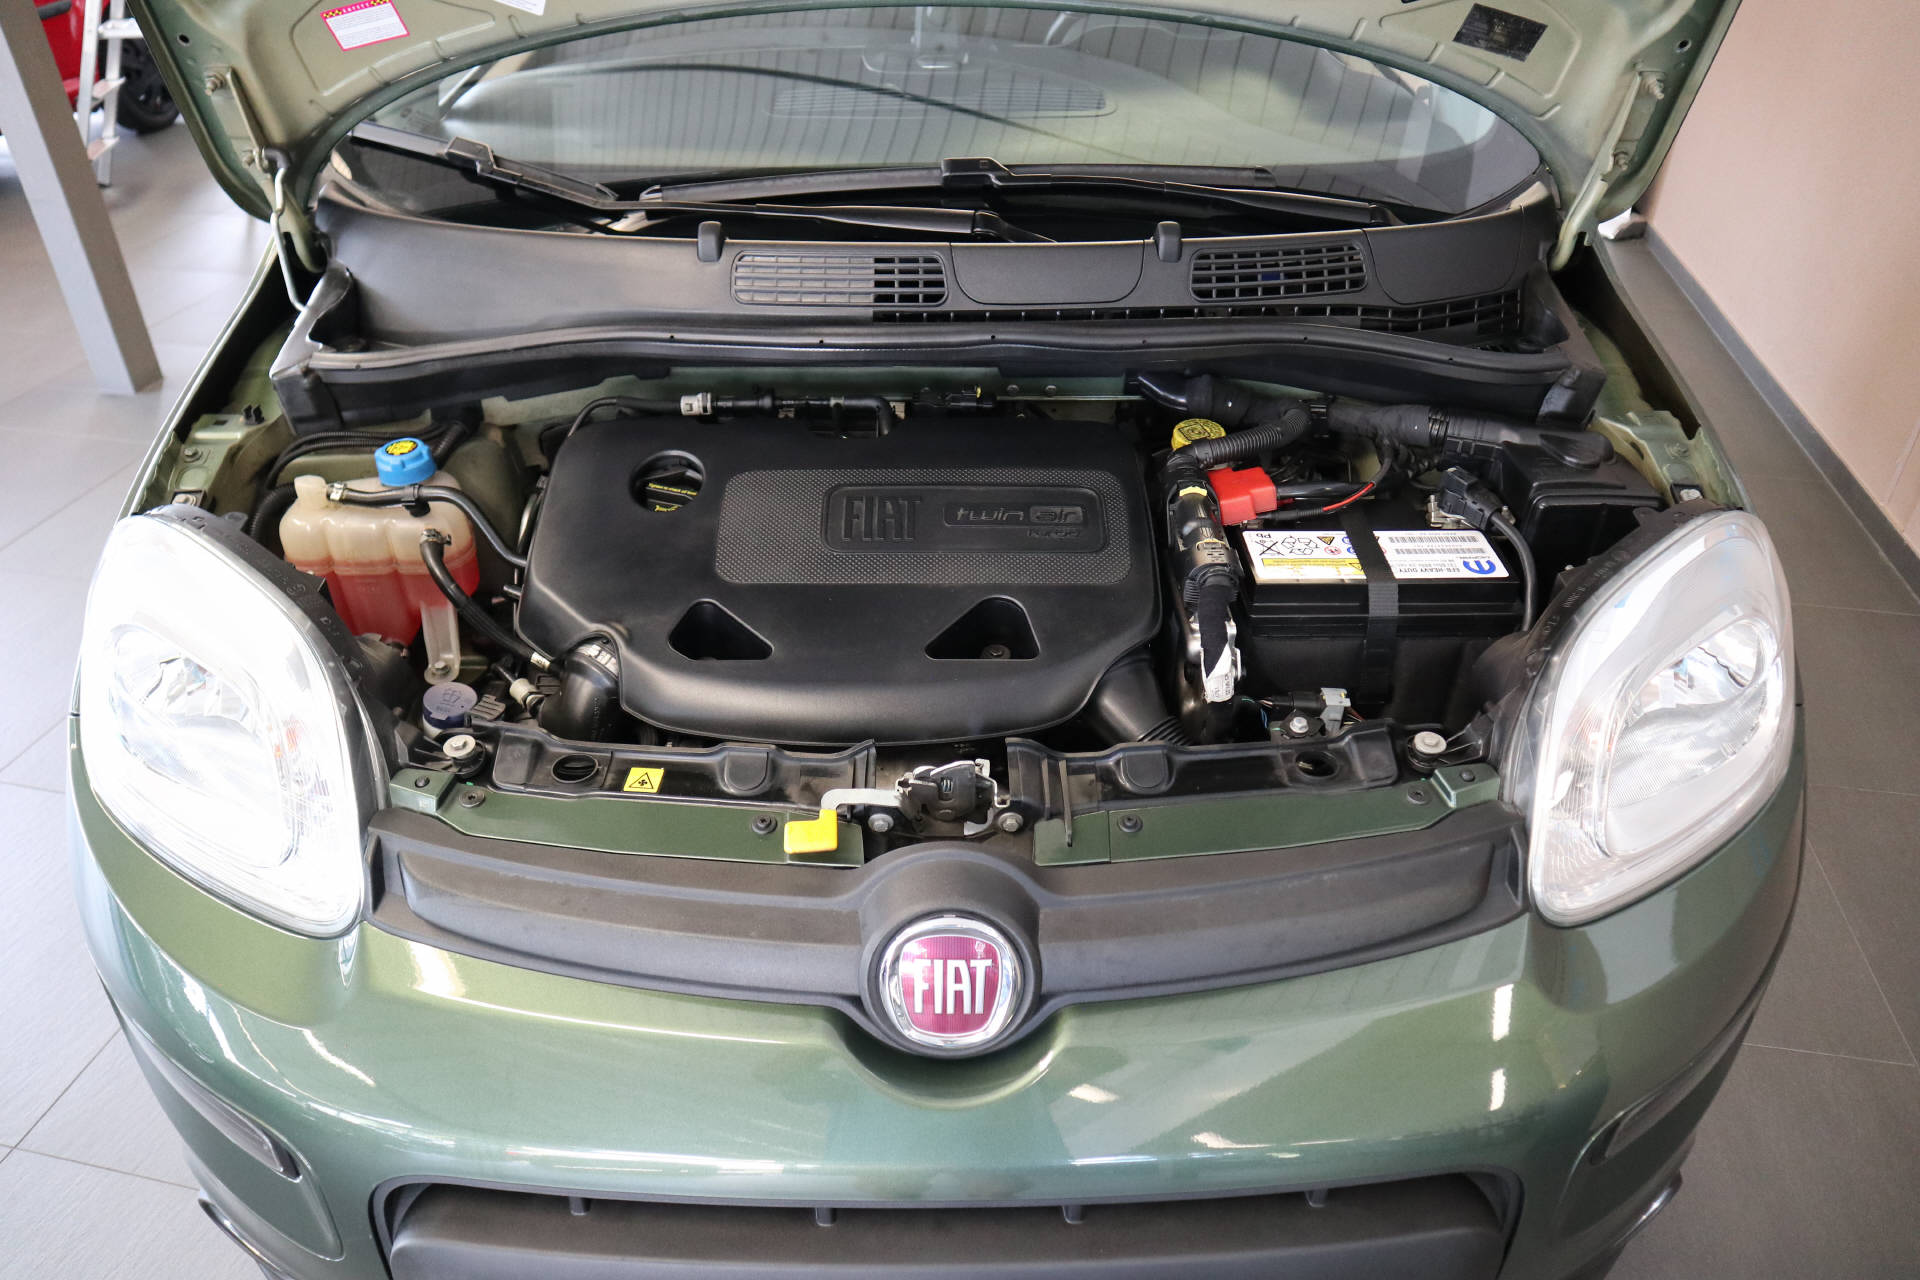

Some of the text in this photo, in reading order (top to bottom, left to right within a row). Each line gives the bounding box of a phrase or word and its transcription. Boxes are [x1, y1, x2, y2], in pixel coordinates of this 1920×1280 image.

[841, 495, 922, 543] FIAT
[956, 506, 1024, 521] twin
[912, 958, 993, 1015] FIAT
